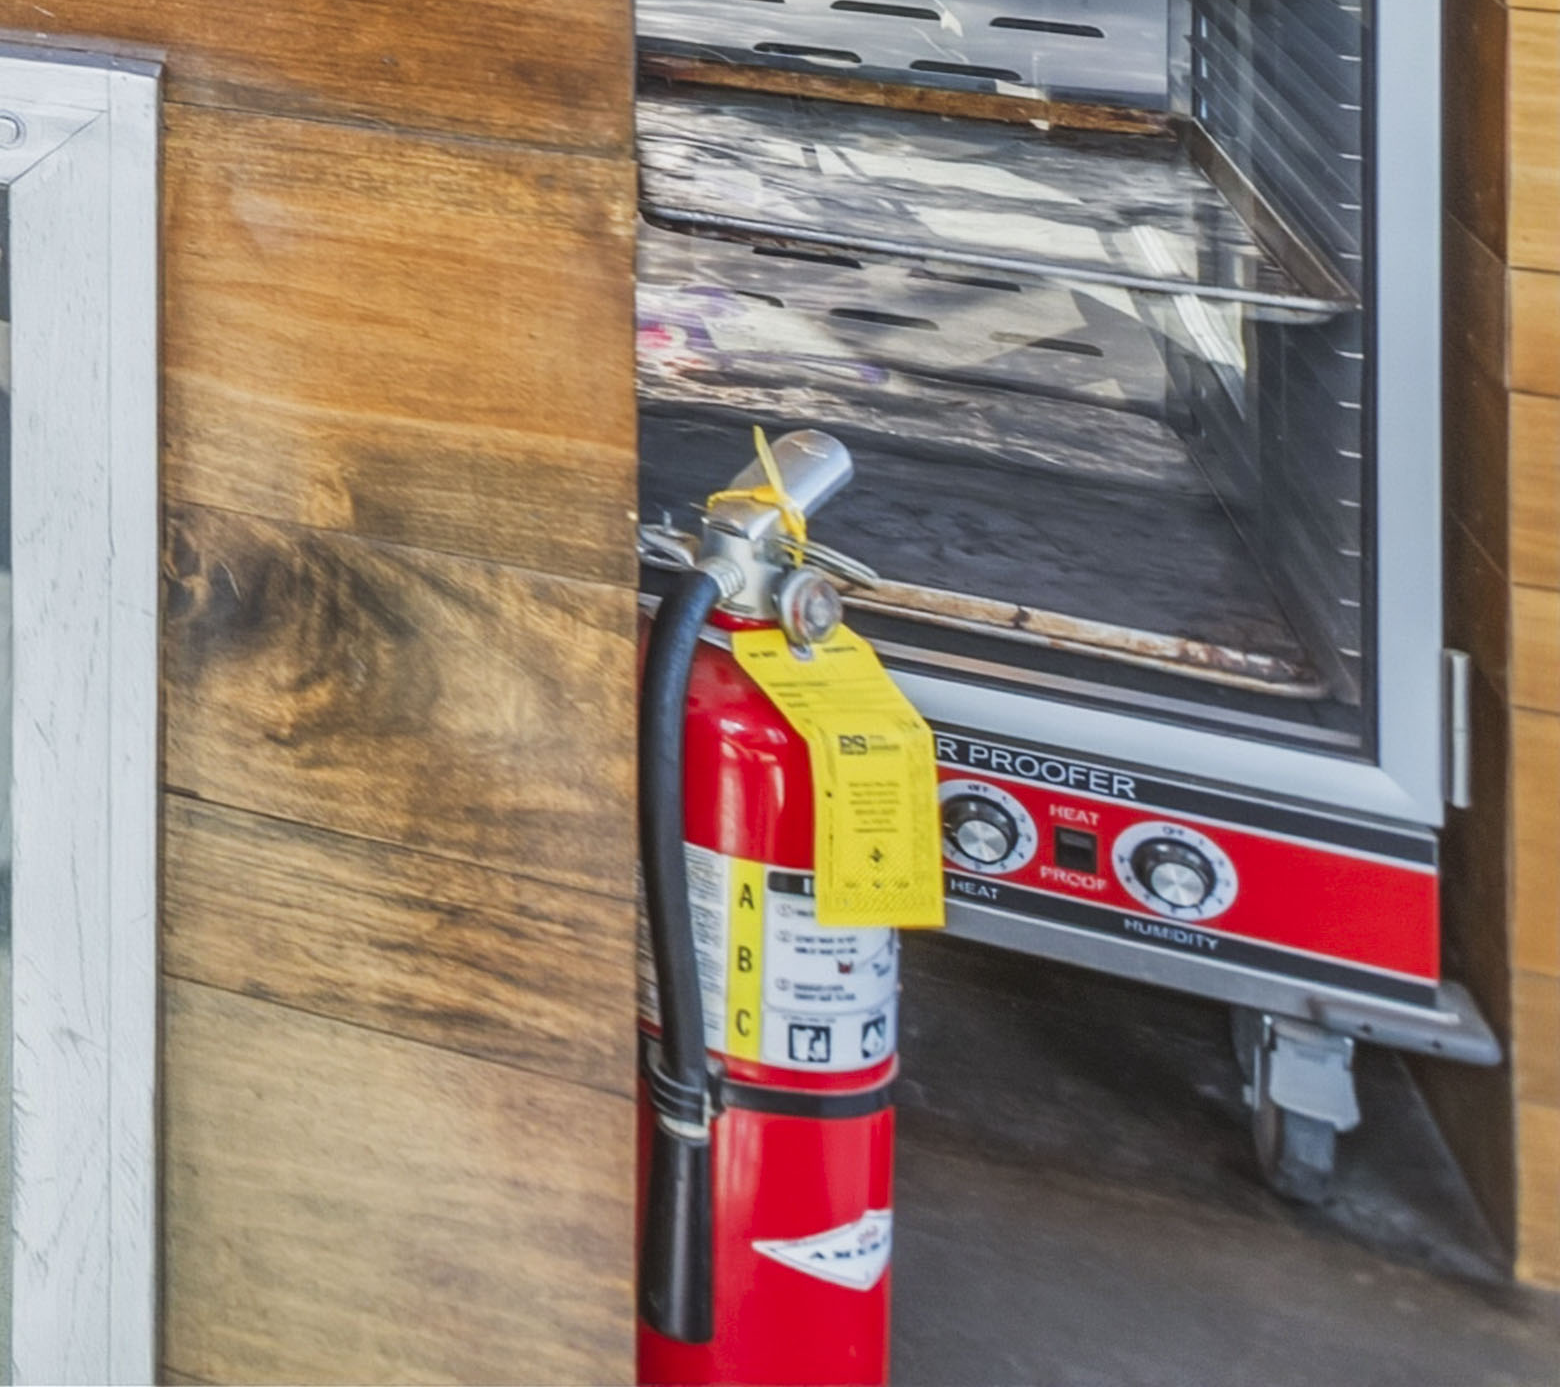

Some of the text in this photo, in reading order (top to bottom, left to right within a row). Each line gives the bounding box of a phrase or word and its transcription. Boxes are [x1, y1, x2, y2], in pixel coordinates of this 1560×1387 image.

[968, 744, 1138, 800] PROOFER
[1049, 803, 1100, 827] HEAT
[950, 878, 1000, 901] HEAT
[1039, 864, 1108, 893] PROOF
[738, 882, 755, 911] A
[1123, 917, 1221, 951] HUMIDITY
[736, 945, 753, 973] B
[734, 1008, 752, 1037] C
